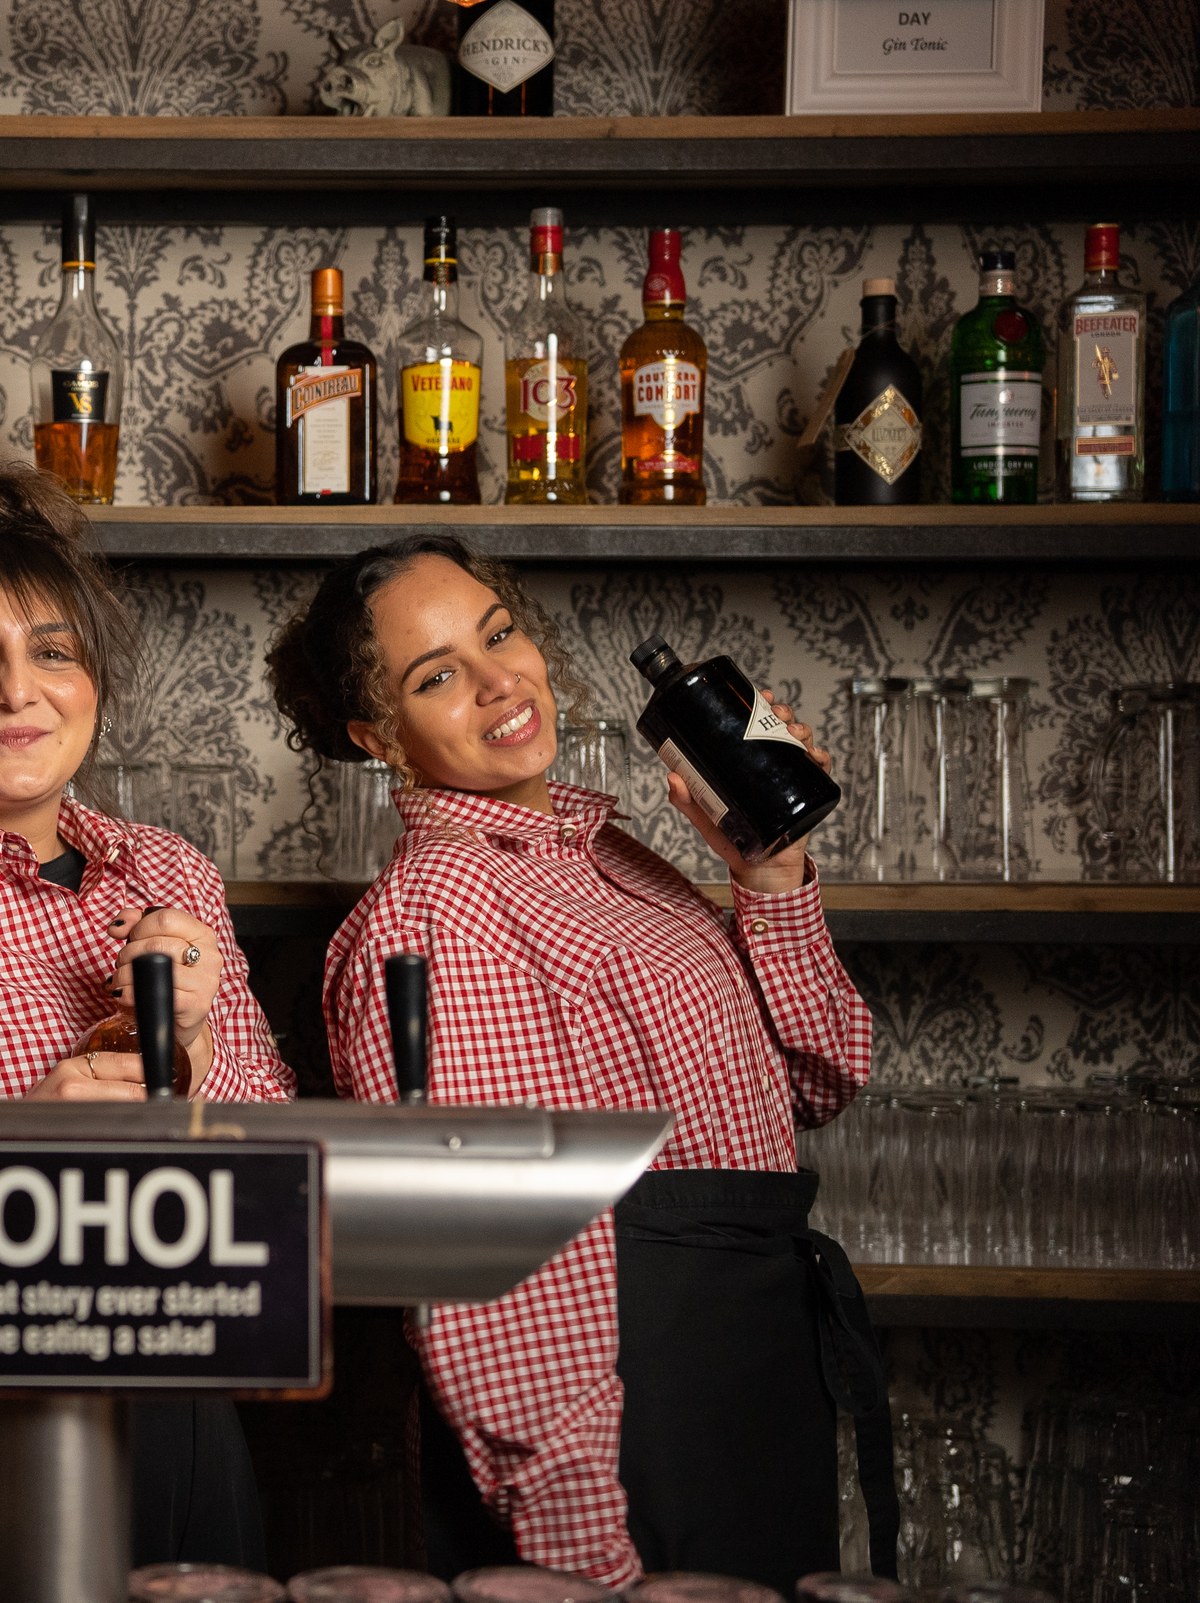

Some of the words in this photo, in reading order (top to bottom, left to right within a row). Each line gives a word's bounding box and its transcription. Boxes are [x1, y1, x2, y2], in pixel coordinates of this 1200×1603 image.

[898, 12, 931, 26] DAY
[882, 38, 907, 55] Gin
[910, 37, 948, 51] Tonic
[1075, 316, 1137, 335] BEEFEATER
[412, 374, 472, 392] VETEANO
[638, 371, 695, 384] SOUTERN
[294, 375, 358, 410] COINTREAU
[520, 375, 577, 412] 103
[637, 384, 695, 402] COMORT
[68, 392, 92, 414] VS
[758, 714, 784, 731] HE
[22, 1280, 95, 1322] story
[96, 1285, 161, 1316] ever
[162, 1281, 262, 1317] started
[22, 1319, 110, 1362] eating
[113, 1324, 135, 1356] a
[137, 1319, 216, 1356] salad
